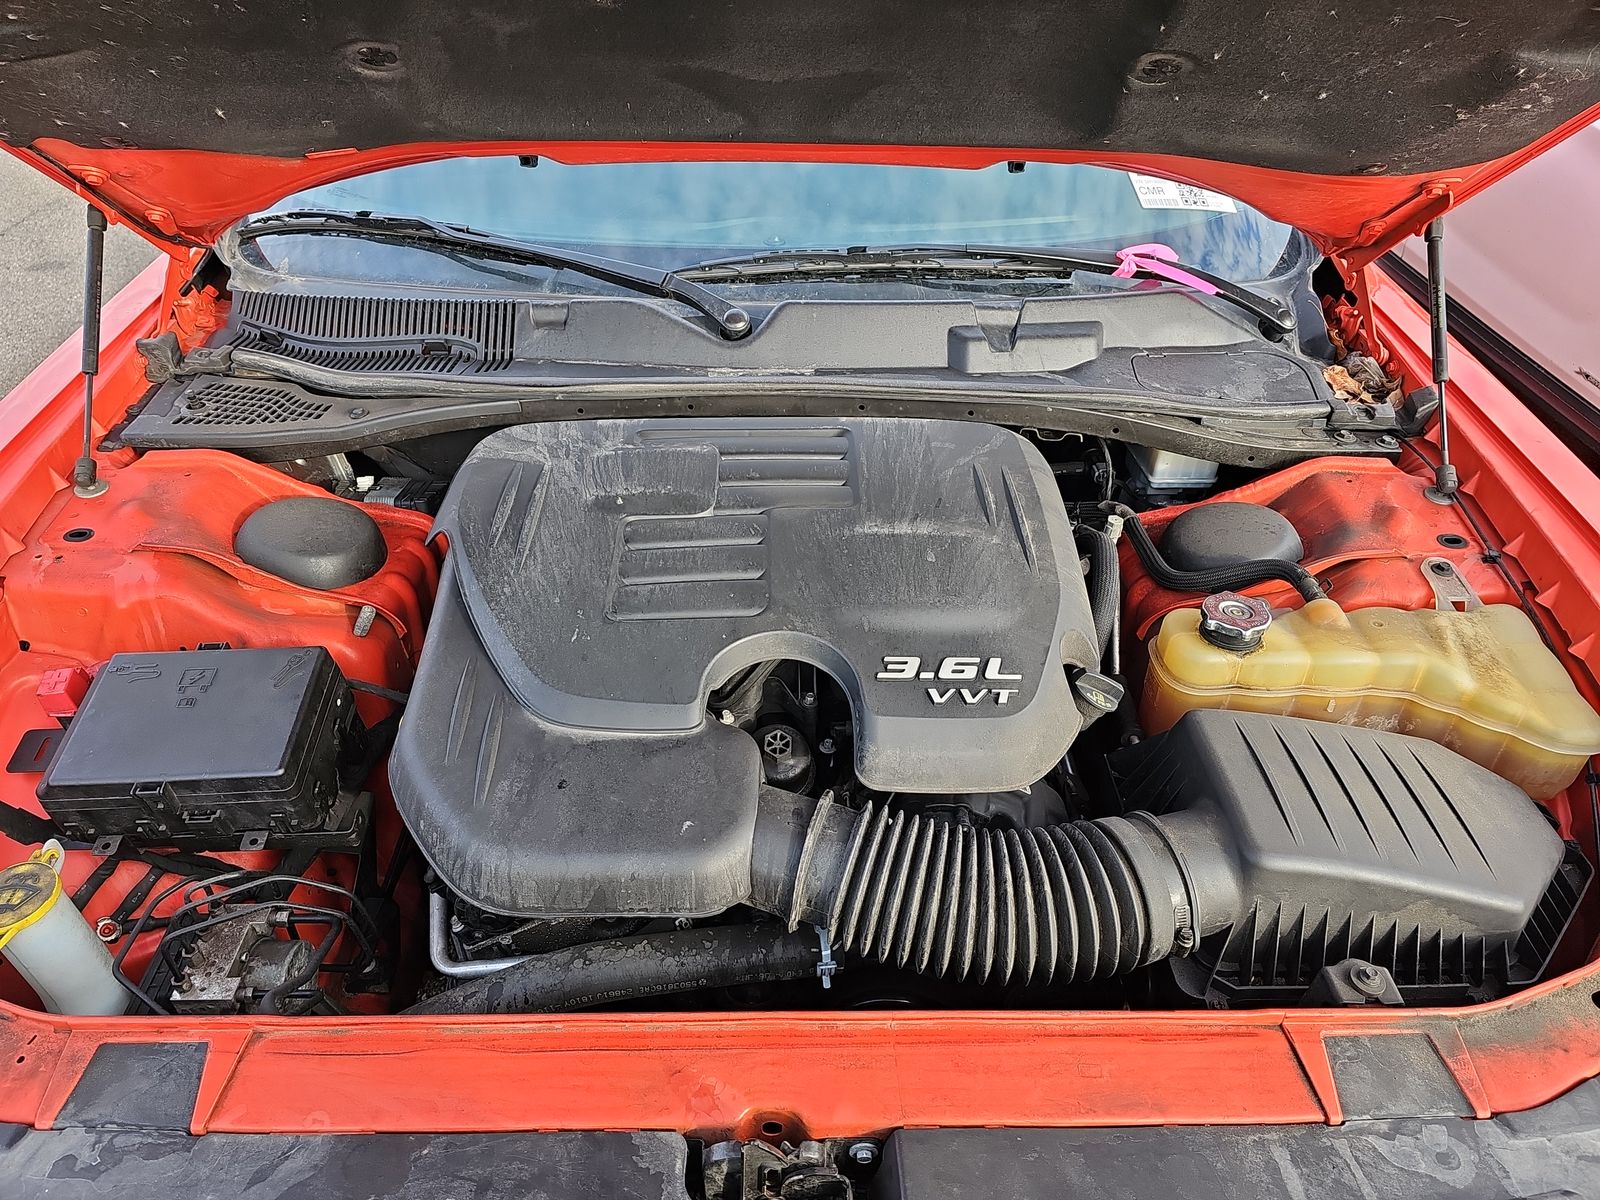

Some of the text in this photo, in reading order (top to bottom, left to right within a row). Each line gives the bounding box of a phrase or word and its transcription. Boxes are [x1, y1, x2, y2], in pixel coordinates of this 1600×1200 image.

[1138, 186, 1166, 196] CMR
[876, 656, 1023, 681] 3.6L
[926, 688, 1020, 705] VVT
